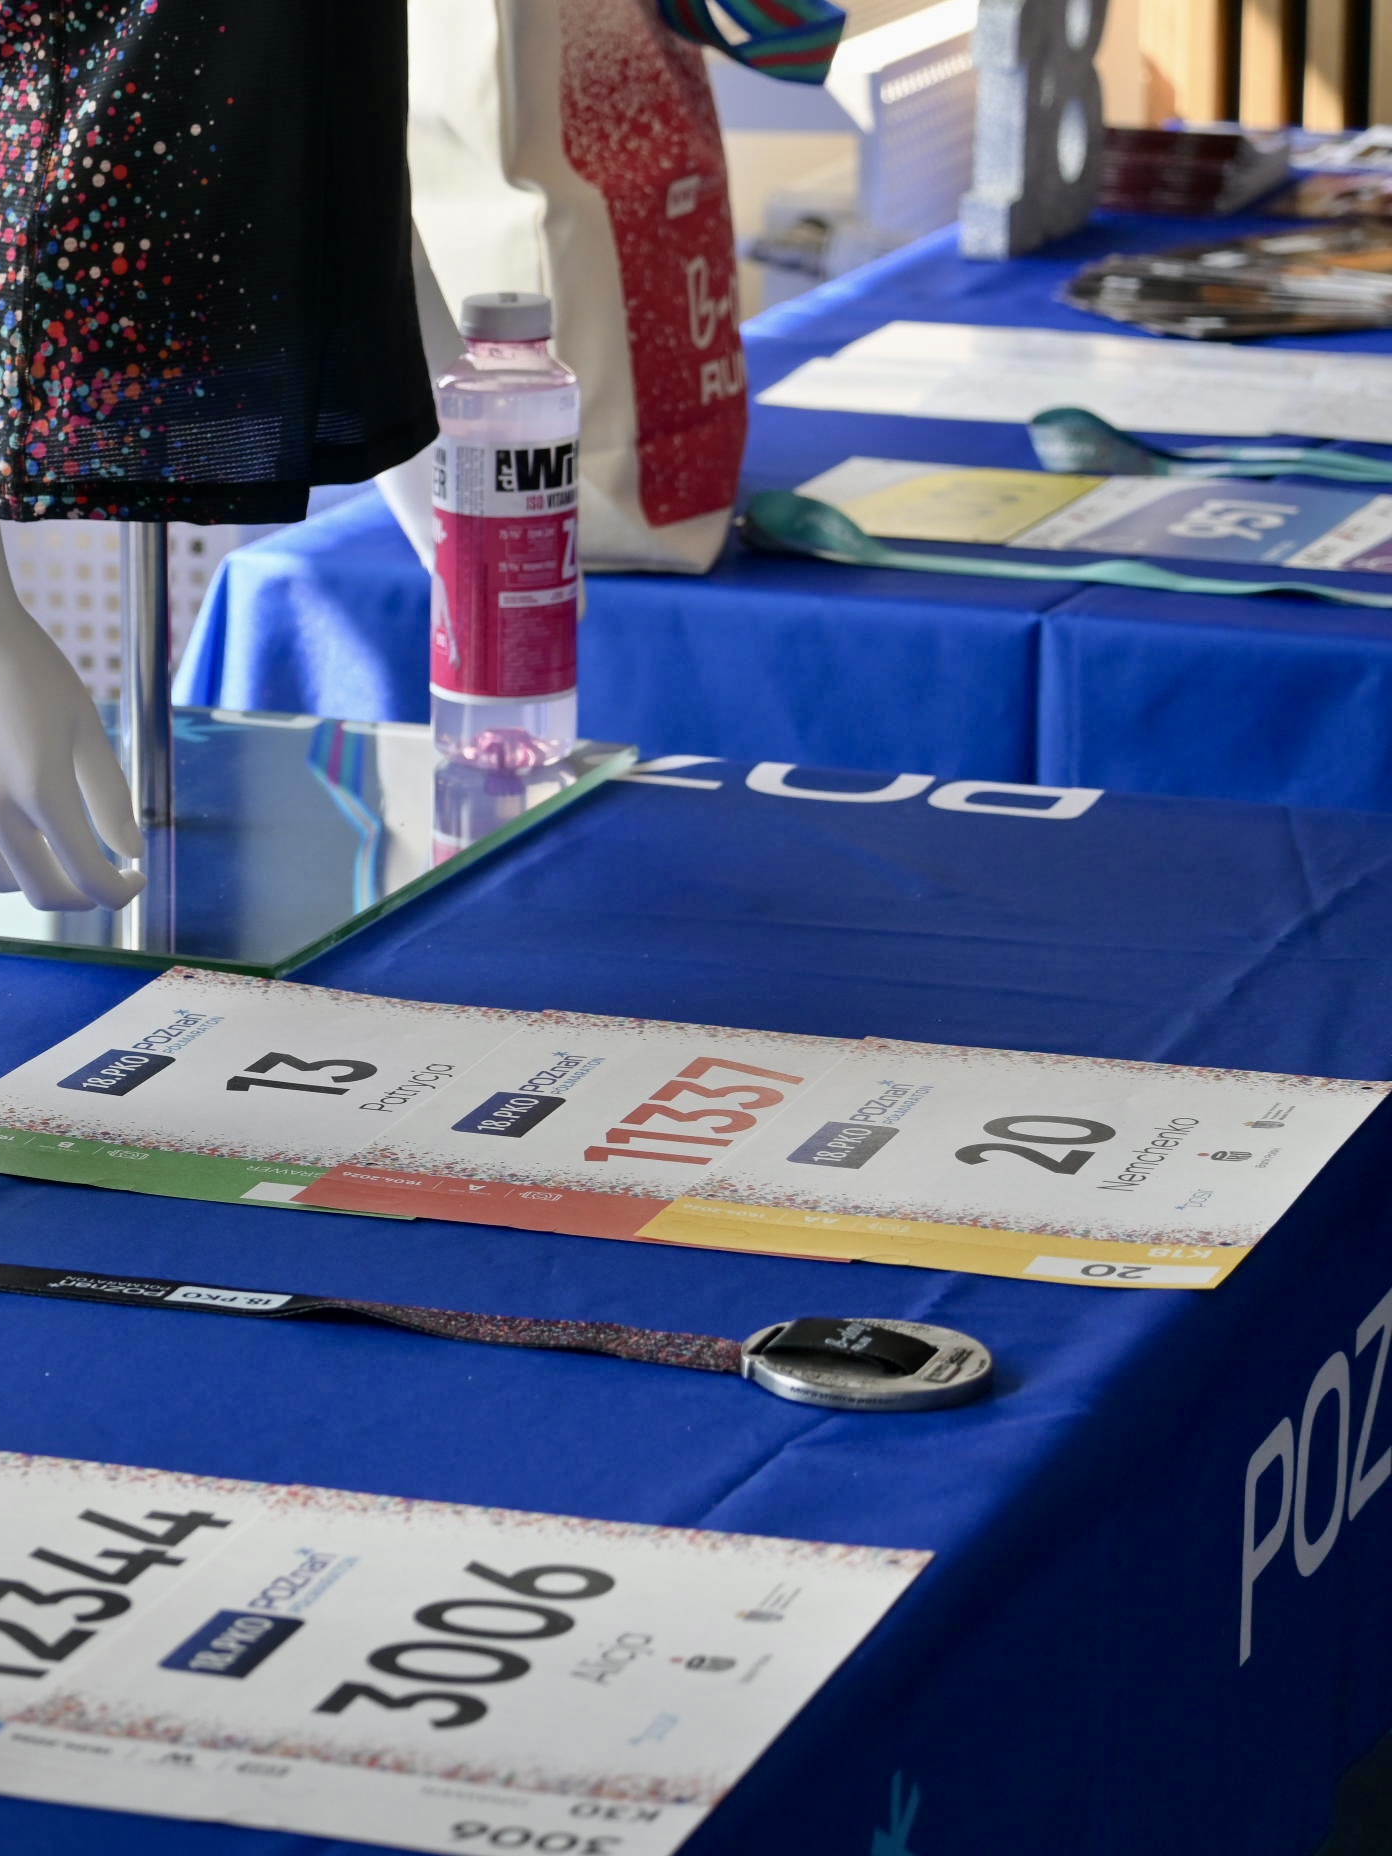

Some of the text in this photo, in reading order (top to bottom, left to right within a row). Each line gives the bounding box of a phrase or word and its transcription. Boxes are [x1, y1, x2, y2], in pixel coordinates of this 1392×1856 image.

[80, 1050, 151, 1092] 18.PKO
[225, 1051, 379, 1097] 13
[358, 1062, 456, 1113] Patrycja
[476, 1095, 541, 1134] 18.PKO
[583, 1055, 806, 1167] 11337
[812, 1124, 873, 1166] 18.PKO
[953, 1114, 1117, 1177] 20
[1096, 1115, 1200, 1193] Nemchenko
[467, 1183, 488, 1192] A
[1080, 1263, 1152, 1280] 20
[1146, 1247, 1214, 1260] K18
[181, 1291, 239, 1304] PKO
[188, 1615, 277, 1672] 18.PKO
[312, 1559, 617, 1730] 3006
[570, 1631, 655, 1687] Alicja
[567, 1801, 663, 1825] K30
[448, 1820, 626, 1856] 3006
